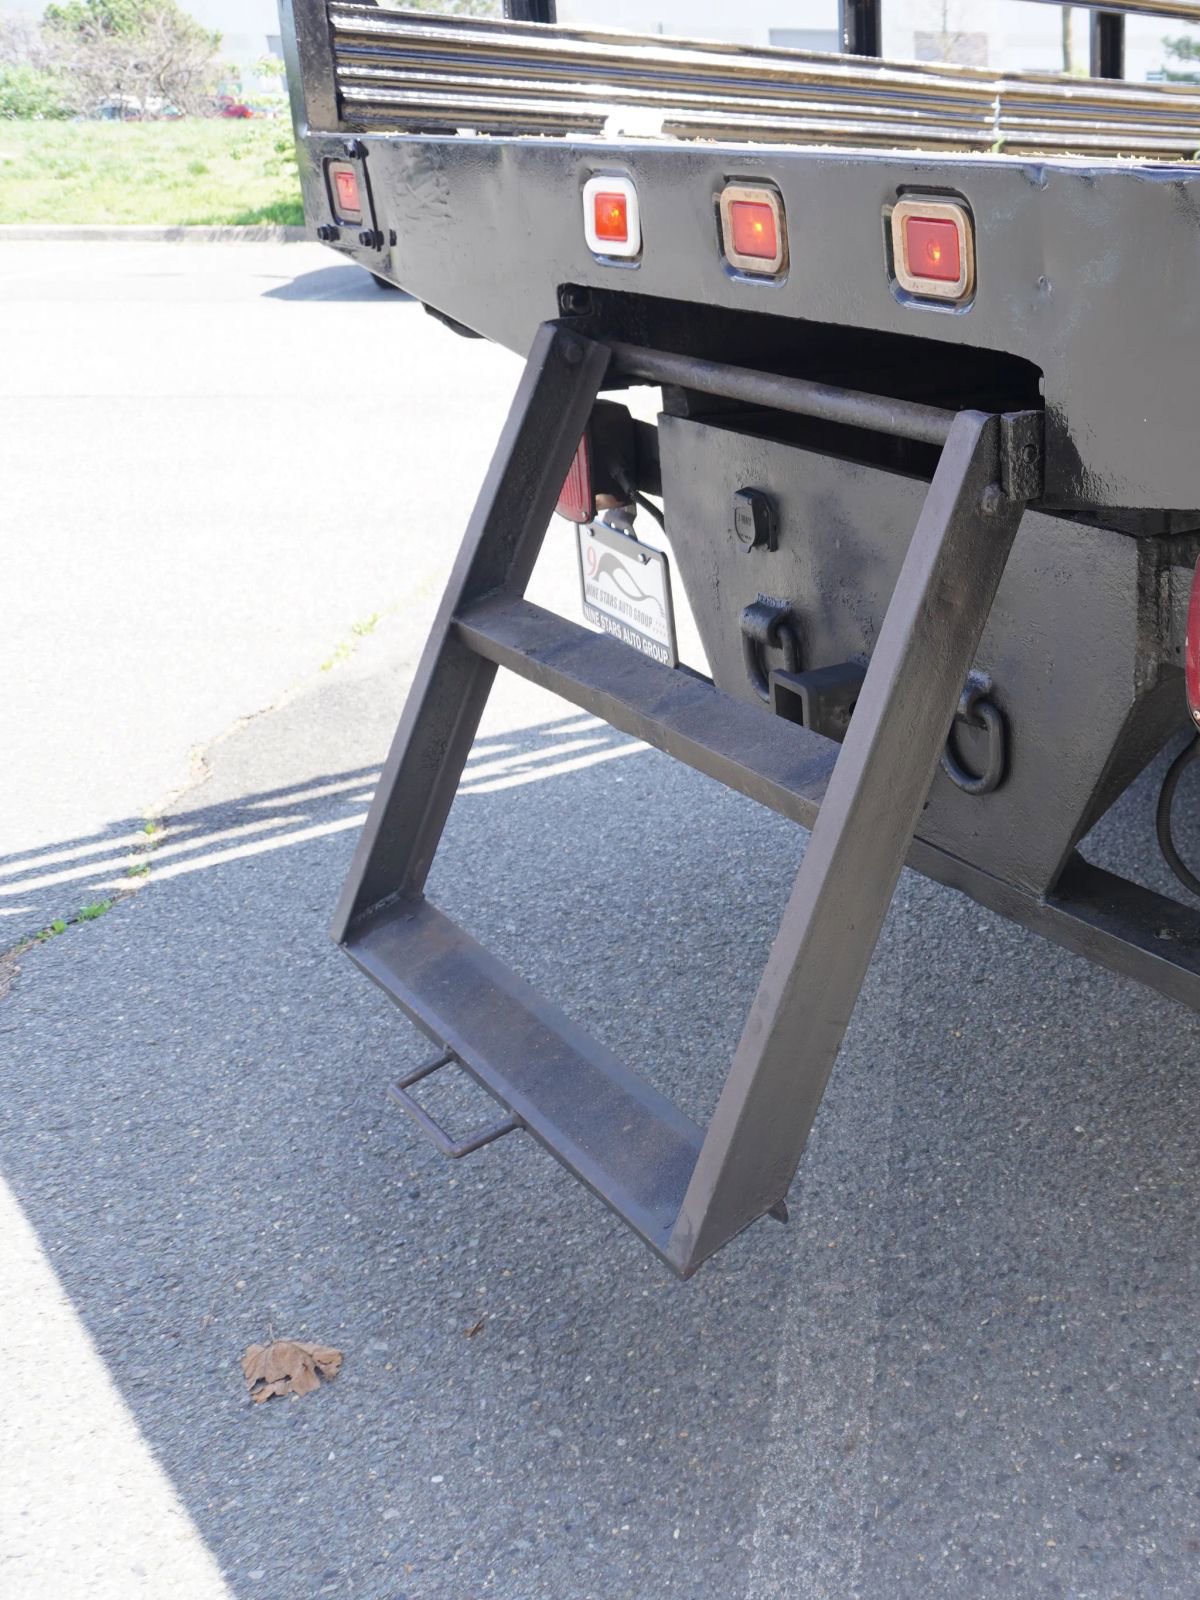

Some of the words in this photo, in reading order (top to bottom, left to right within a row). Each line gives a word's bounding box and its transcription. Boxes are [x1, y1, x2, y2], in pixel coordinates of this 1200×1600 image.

[586, 583, 599, 601] NINE
[599, 588, 618, 609] STARS
[618, 599, 633, 619] AUTO
[633, 607, 653, 628] GROUP
[584, 605, 600, 626] NINE
[600, 615, 622, 639] STARS
[623, 628, 642, 650] AUTO
[643, 639, 669, 665] GROUP
